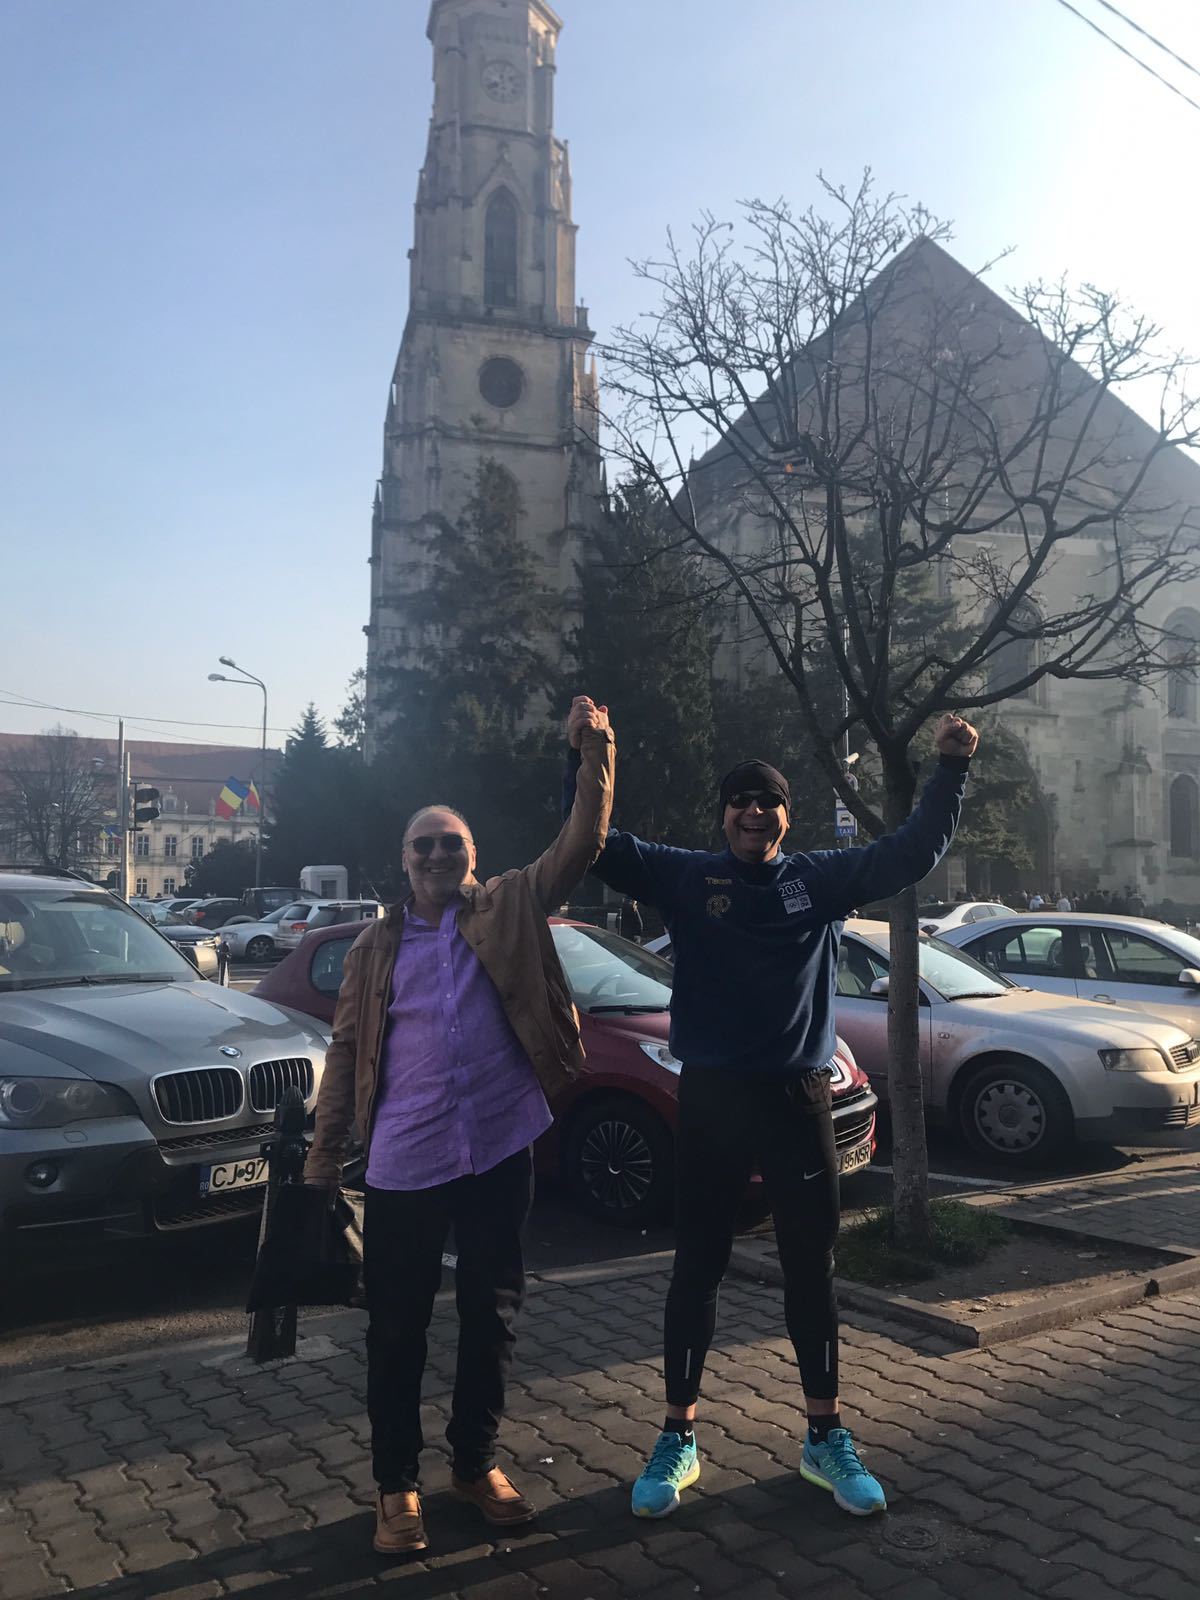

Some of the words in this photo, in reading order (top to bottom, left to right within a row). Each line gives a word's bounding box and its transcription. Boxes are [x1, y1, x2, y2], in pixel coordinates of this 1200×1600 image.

[778, 881, 806, 897] 2016
[212, 1164, 238, 1188] CJ
[244, 1159, 267, 1182] 97
